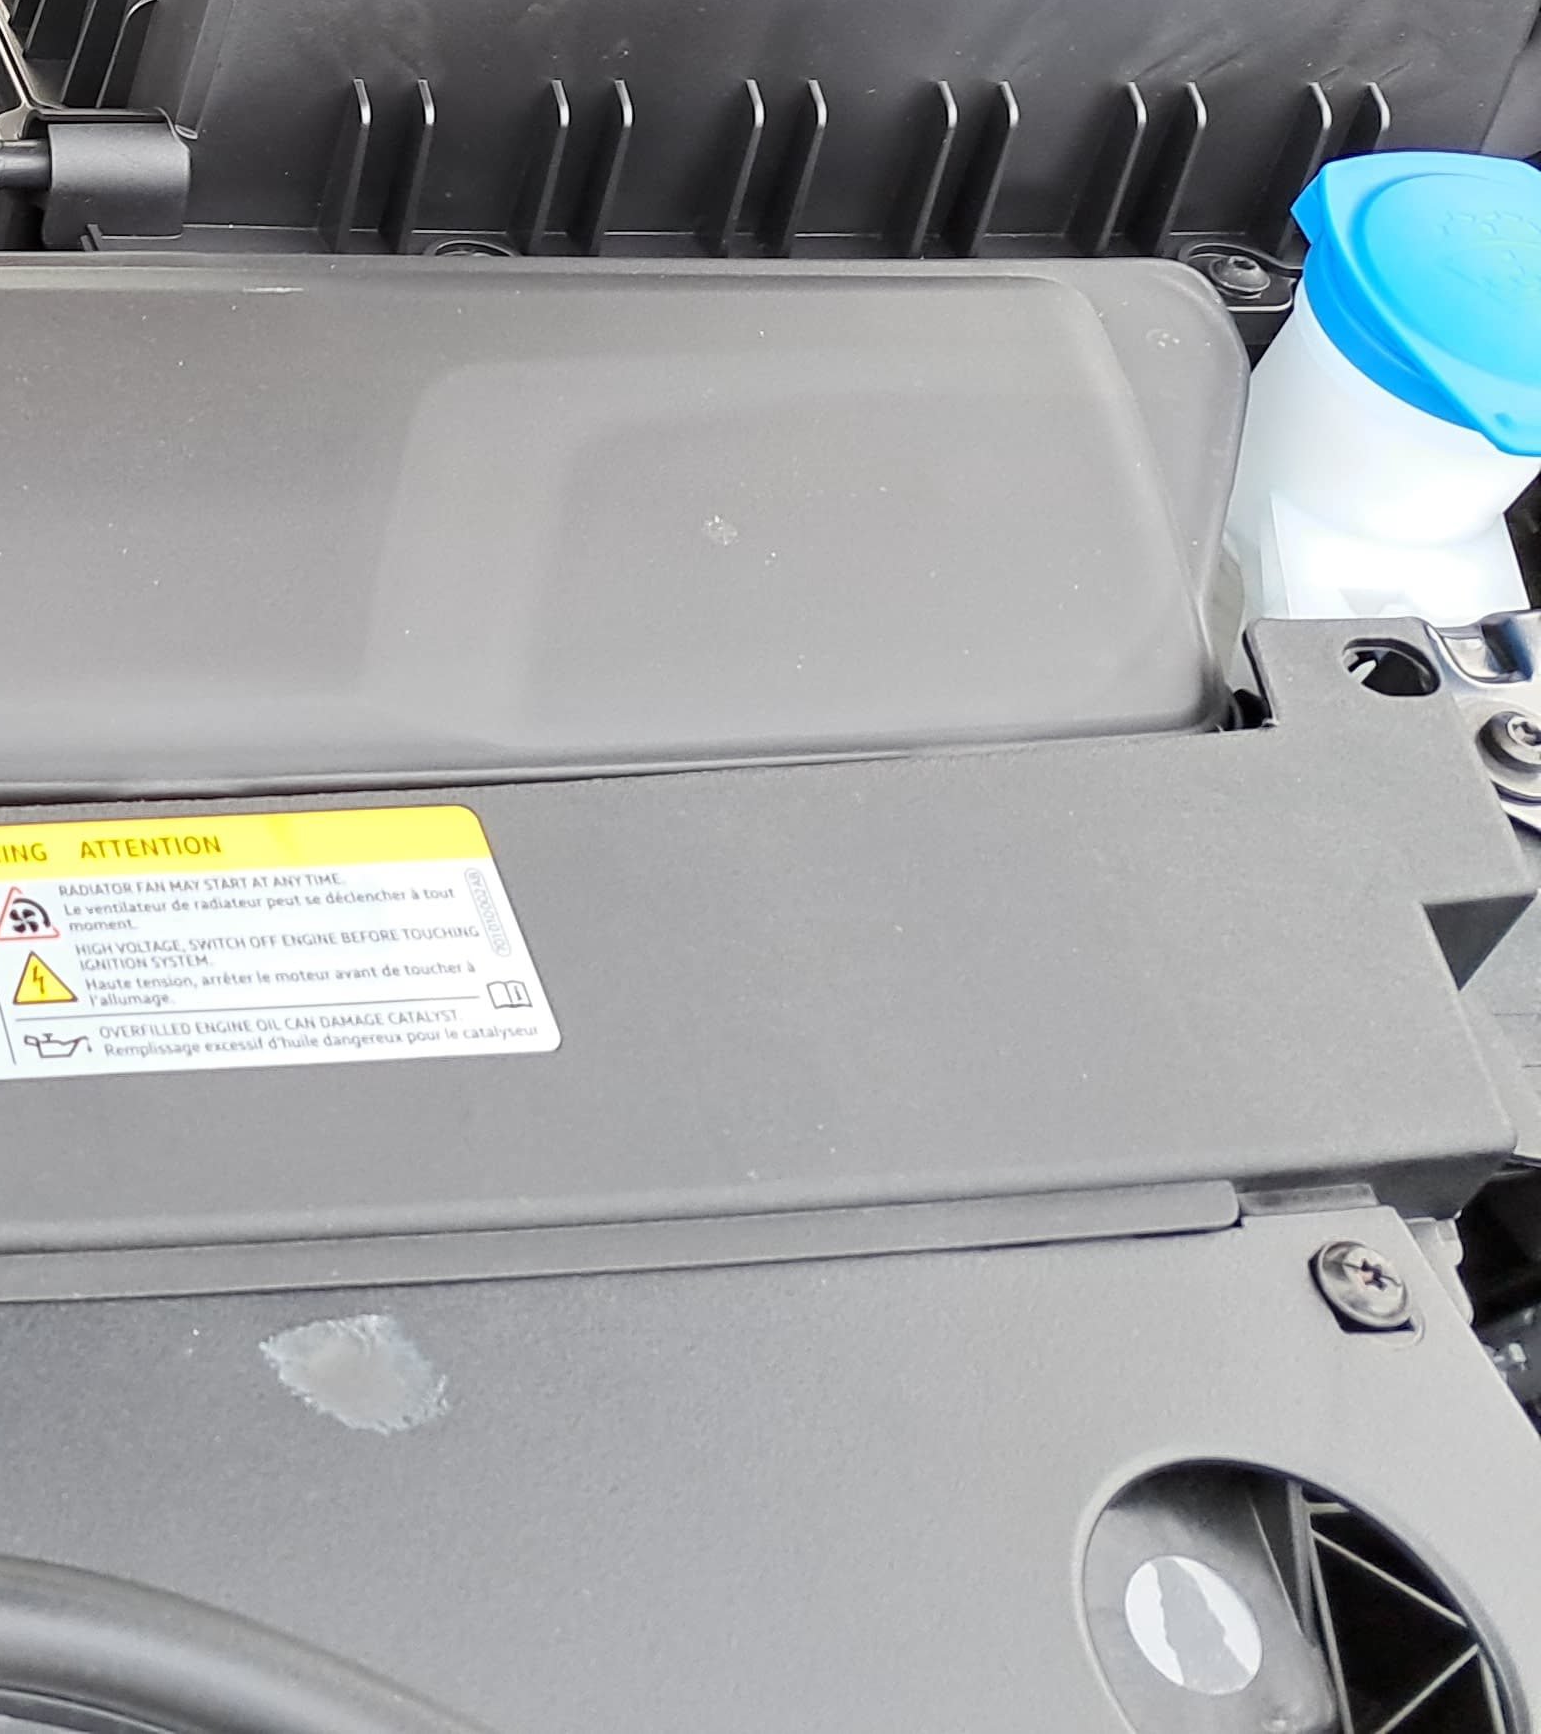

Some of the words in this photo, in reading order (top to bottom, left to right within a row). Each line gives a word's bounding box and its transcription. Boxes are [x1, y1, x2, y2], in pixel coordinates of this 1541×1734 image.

[82, 836, 221, 860] ATTENTION
[59, 881, 132, 897] RADIATOR
[137, 881, 165, 892] FAN
[169, 879, 199, 891] MAY
[204, 877, 247, 890] START
[252, 876, 268, 887] AT
[273, 875, 301, 887] ANY
[64, 904, 82, 916] Le
[85, 900, 166, 914] ventilateur
[171, 899, 189, 911] de
[194, 897, 262, 910] radiateur
[267, 895, 300, 910] peut
[305, 895, 321, 905] se
[326, 890, 406, 905] déclencher
[411, 890, 420, 900] à
[424, 888, 454, 899] tout
[75, 944, 113, 956] HIGH
[188, 937, 246, 951] SWITCH
[250, 935, 277, 948] OFF
[282, 934, 336, 946] ENGINE
[342, 929, 399, 943] BEFORE
[404, 926, 479, 940] TOUCHING
[80, 958, 147, 971] IGNITION
[86, 979, 131, 991] Haute
[136, 974, 198, 989] tension,
[202, 972, 253, 985] arrêter
[256, 972, 270, 982] le
[276, 969, 330, 982] moteur
[335, 967, 377, 979] avant
[382, 965, 399, 978] de
[404, 962, 462, 975] toucher
[467, 960, 476, 972] à
[99, 1023, 191, 1039] OVERFILLED
[195, 1021, 251, 1034] ENGINE
[256, 1019, 280, 1032] OIL
[284, 1018, 316, 1030] CAN
[320, 1014, 384, 1029] DAMAGE
[104, 1041, 200, 1056] Remplissage
[205, 1038, 264, 1052] excessif
[323, 1031, 402, 1049] dangereux
[407, 1029, 441, 1044] pour
[445, 1028, 458, 1039] le
[463, 1025, 538, 1040] catalyseur
